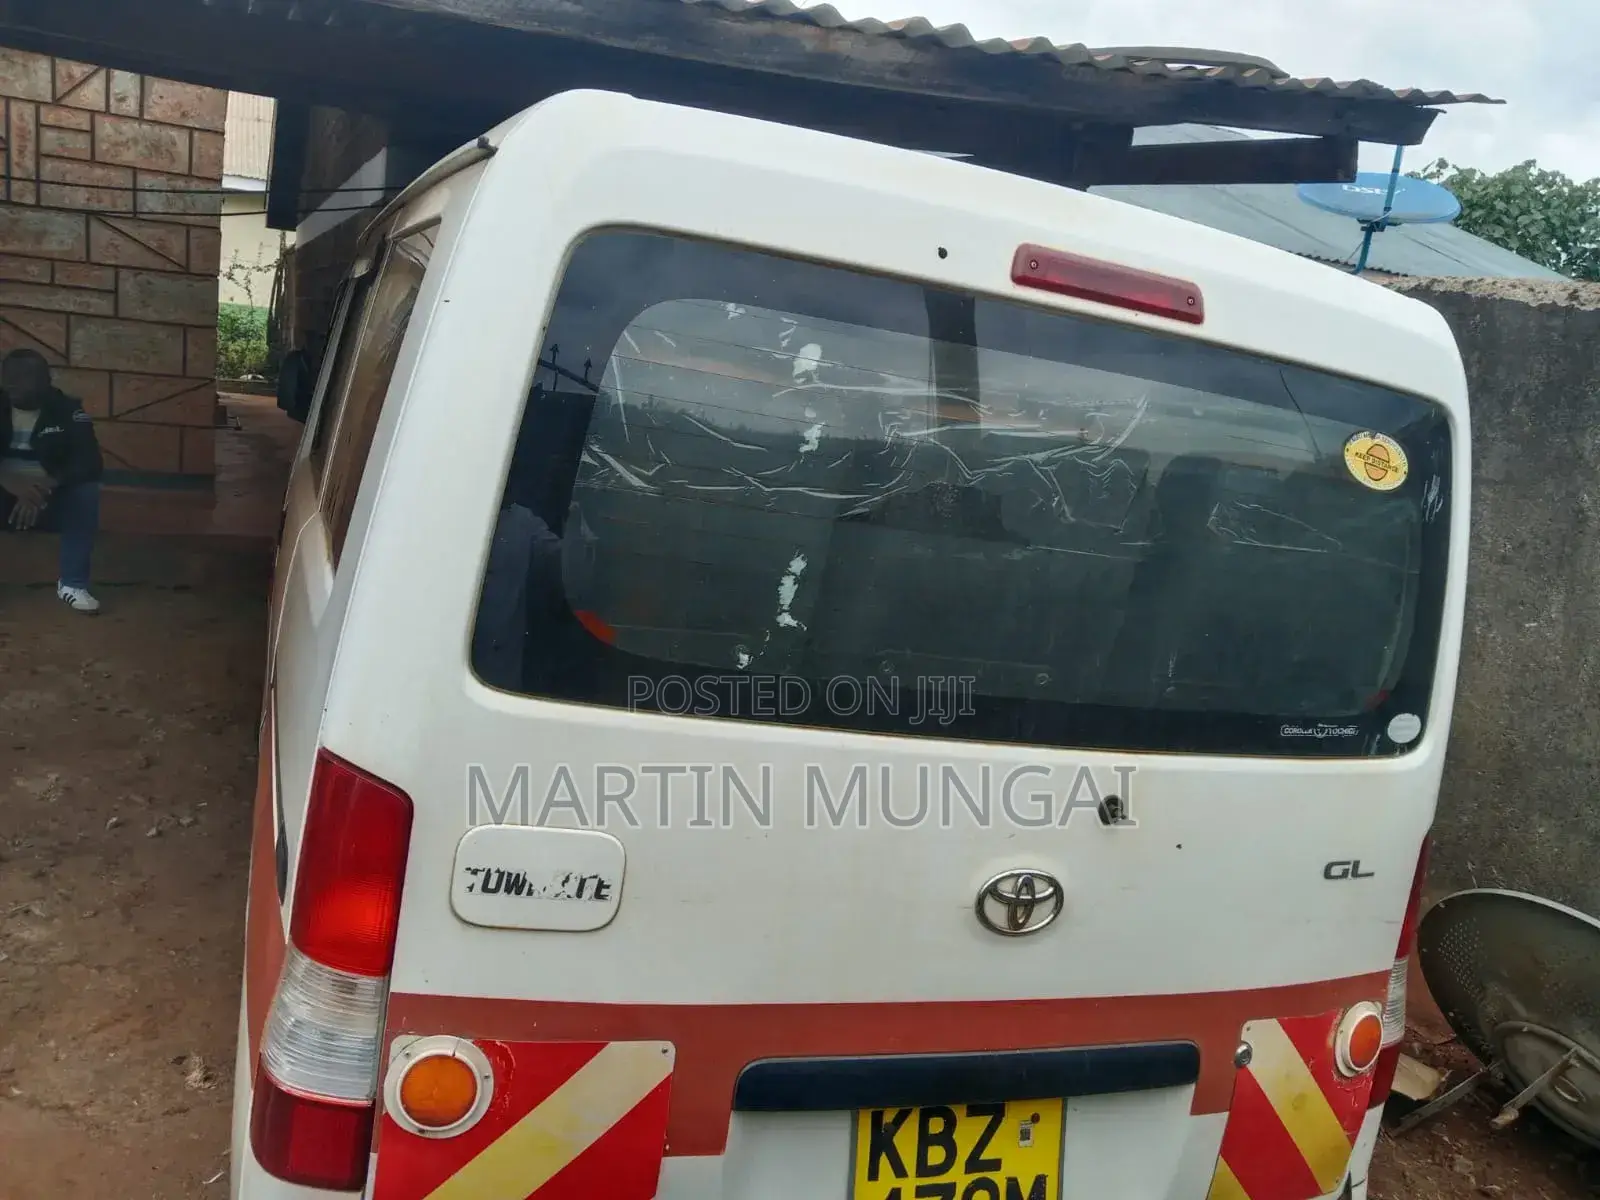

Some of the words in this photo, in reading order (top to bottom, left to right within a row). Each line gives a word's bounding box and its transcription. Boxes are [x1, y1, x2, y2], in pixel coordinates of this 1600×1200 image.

[1354, 452, 1371, 463] KEEP
[1323, 860, 1375, 880] GL
[867, 1102, 1007, 1181] KBZ
